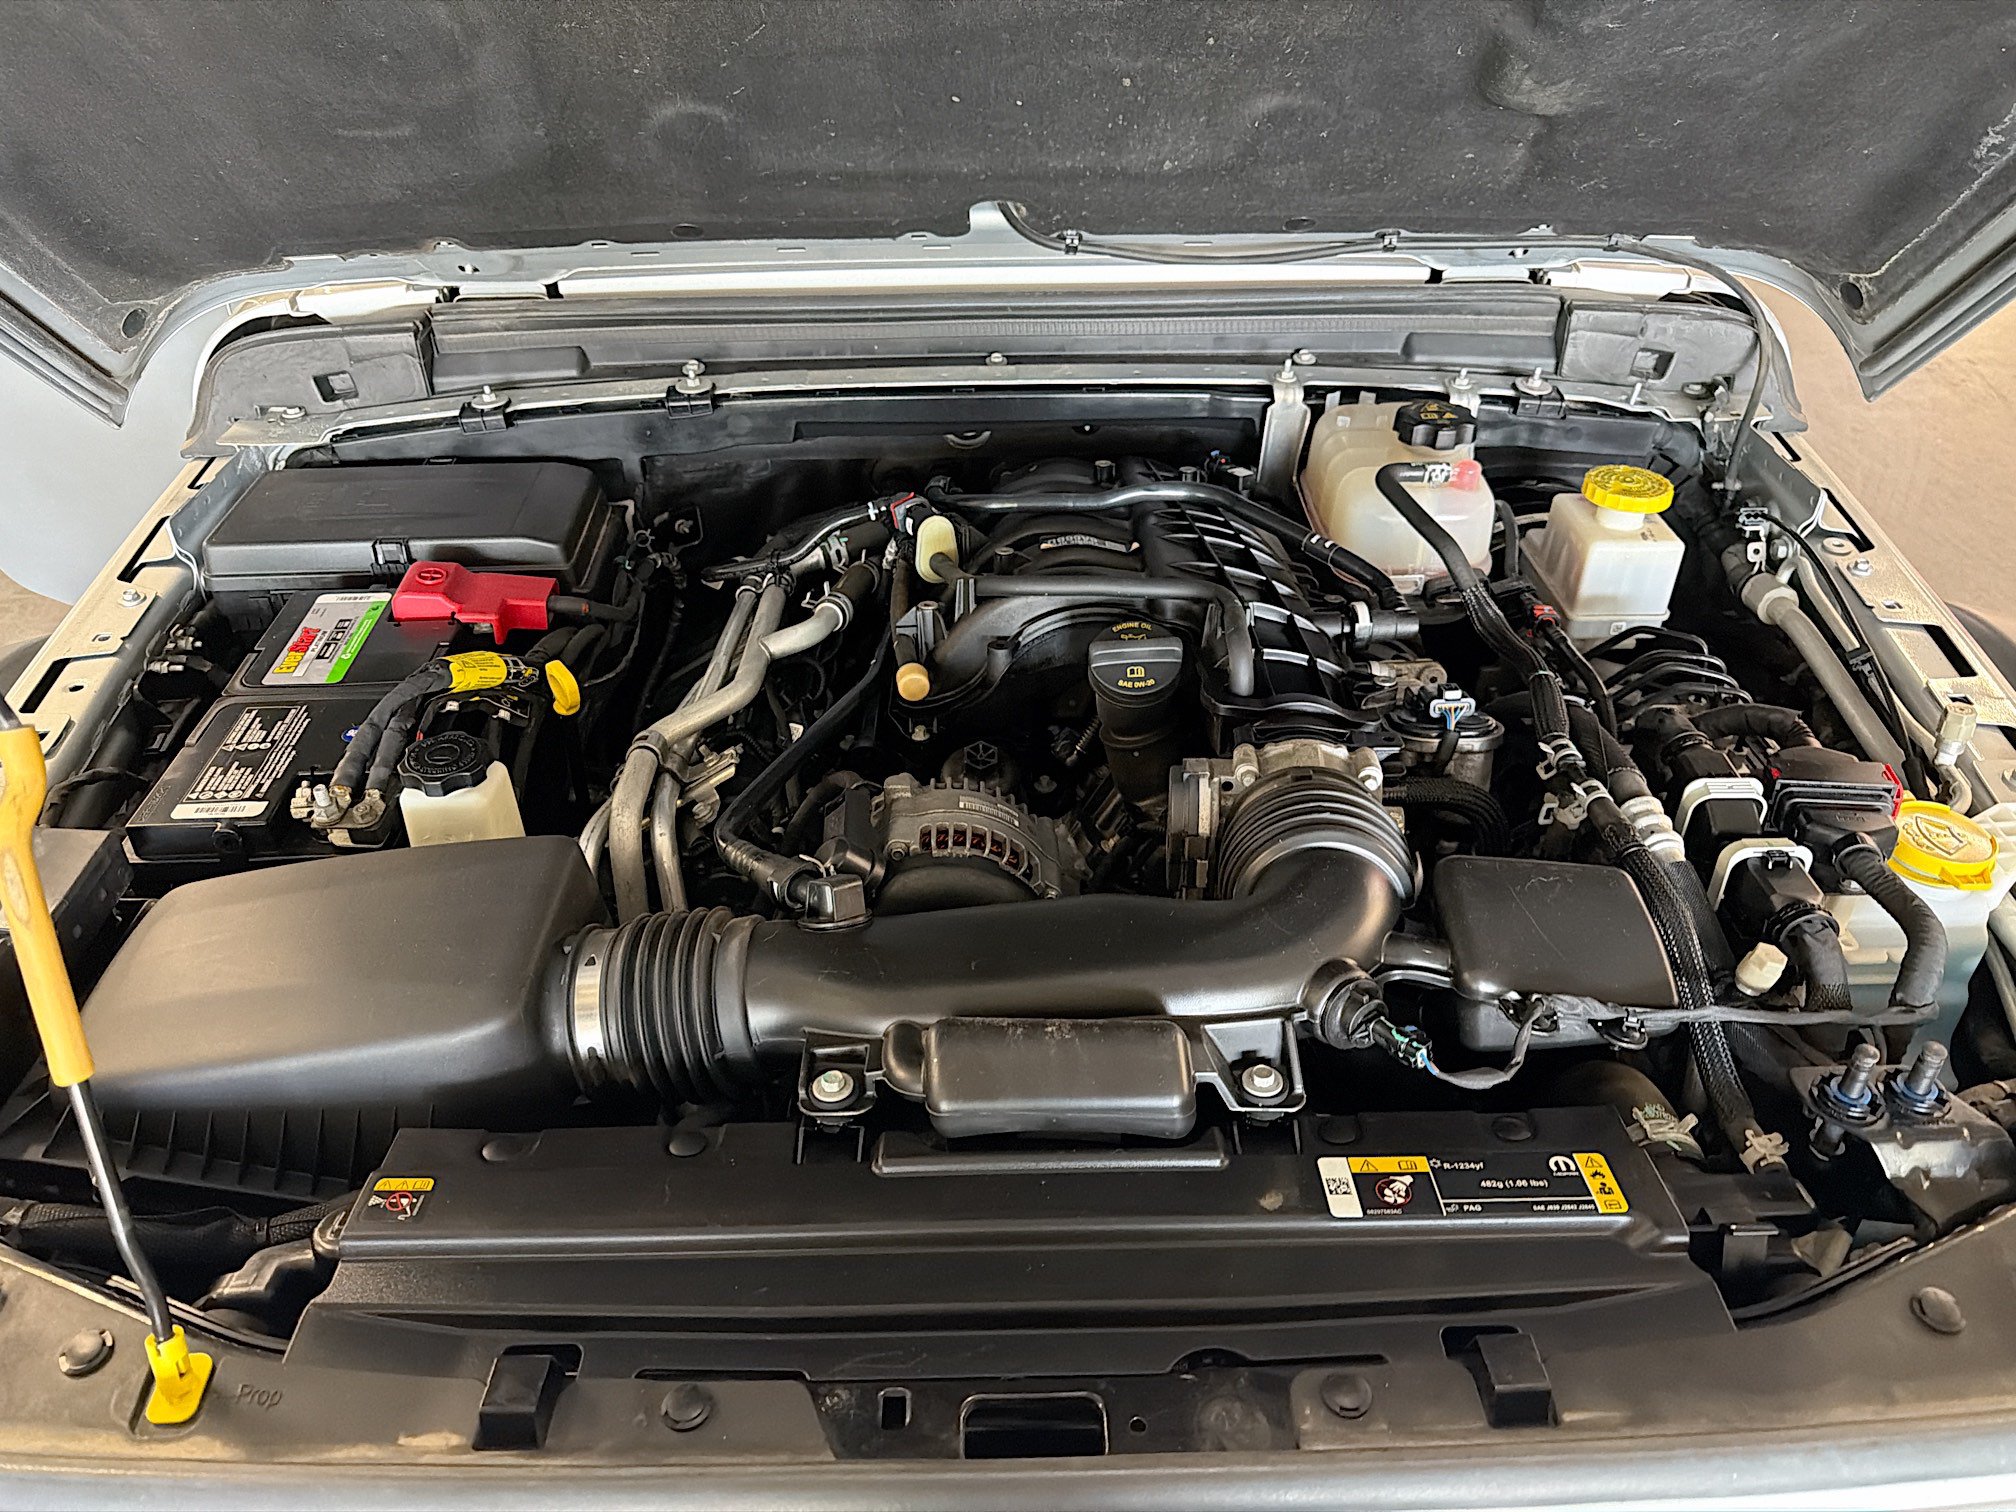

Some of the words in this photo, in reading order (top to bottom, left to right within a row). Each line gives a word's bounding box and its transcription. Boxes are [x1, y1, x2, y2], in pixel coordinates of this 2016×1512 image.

[1112, 622, 1139, 632] ENGINE
[1140, 622, 1152, 631] OIL
[272, 626, 321, 675] EverStart
[1118, 680, 1133, 688] SAE
[1134, 679, 1155, 688] 0W-20
[1442, 1161, 1484, 1171] R-1234yf
[1529, 1179, 1549, 1188] lbs)
[1463, 1204, 1482, 1212] PAG
[235, 1384, 283, 1411] Prop
